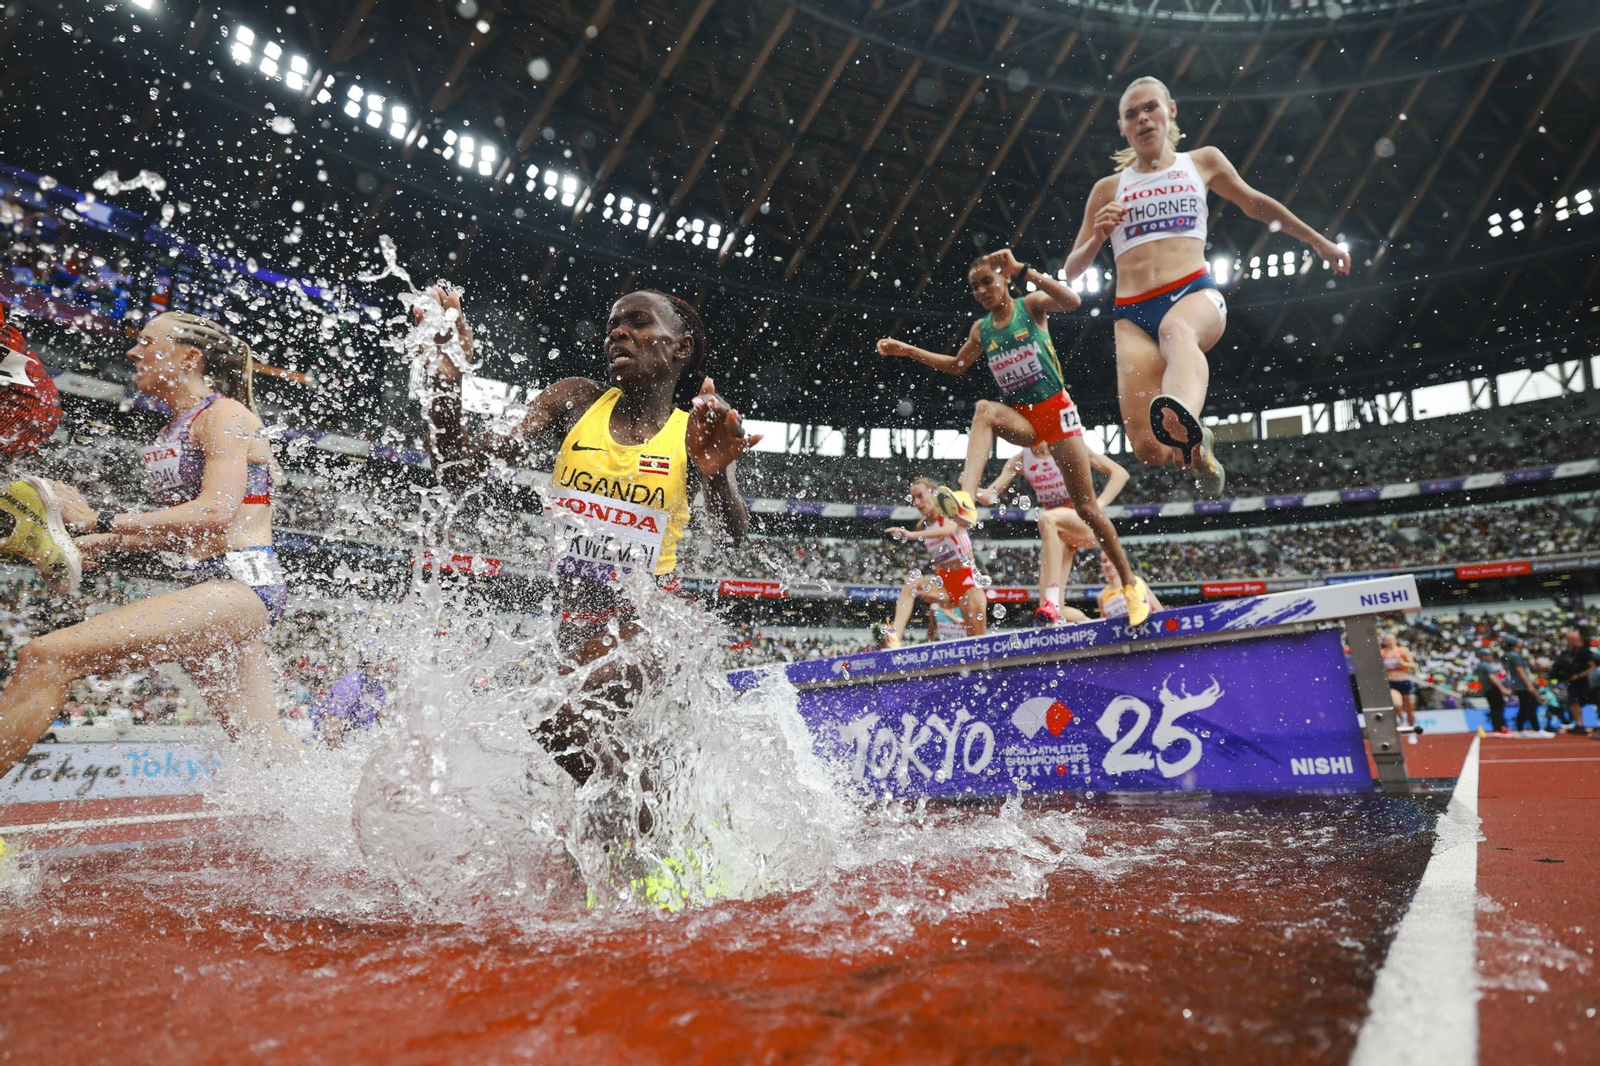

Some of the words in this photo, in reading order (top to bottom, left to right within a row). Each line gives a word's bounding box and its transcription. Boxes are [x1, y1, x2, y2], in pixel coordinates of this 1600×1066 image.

[1123, 184, 1197, 202] HONDA
[1127, 198, 1198, 223] THORNER
[560, 465, 666, 509] UGANDA
[1360, 590, 1408, 606] NISHI
[891, 652, 928, 666] WORLD
[931, 642, 990, 661] ATHLETICS
[995, 629, 1096, 651] CHAMPIONSHIPS
[837, 709, 995, 785] TOKYO
[1096, 673, 1225, 778] 25
[1005, 753, 1090, 767] CHAMPIONSHIPS
[1038, 743, 1089, 755] ATHLETICS
[12, 752, 121, 796] Tokyo
[1291, 756, 1353, 775] NISHI
